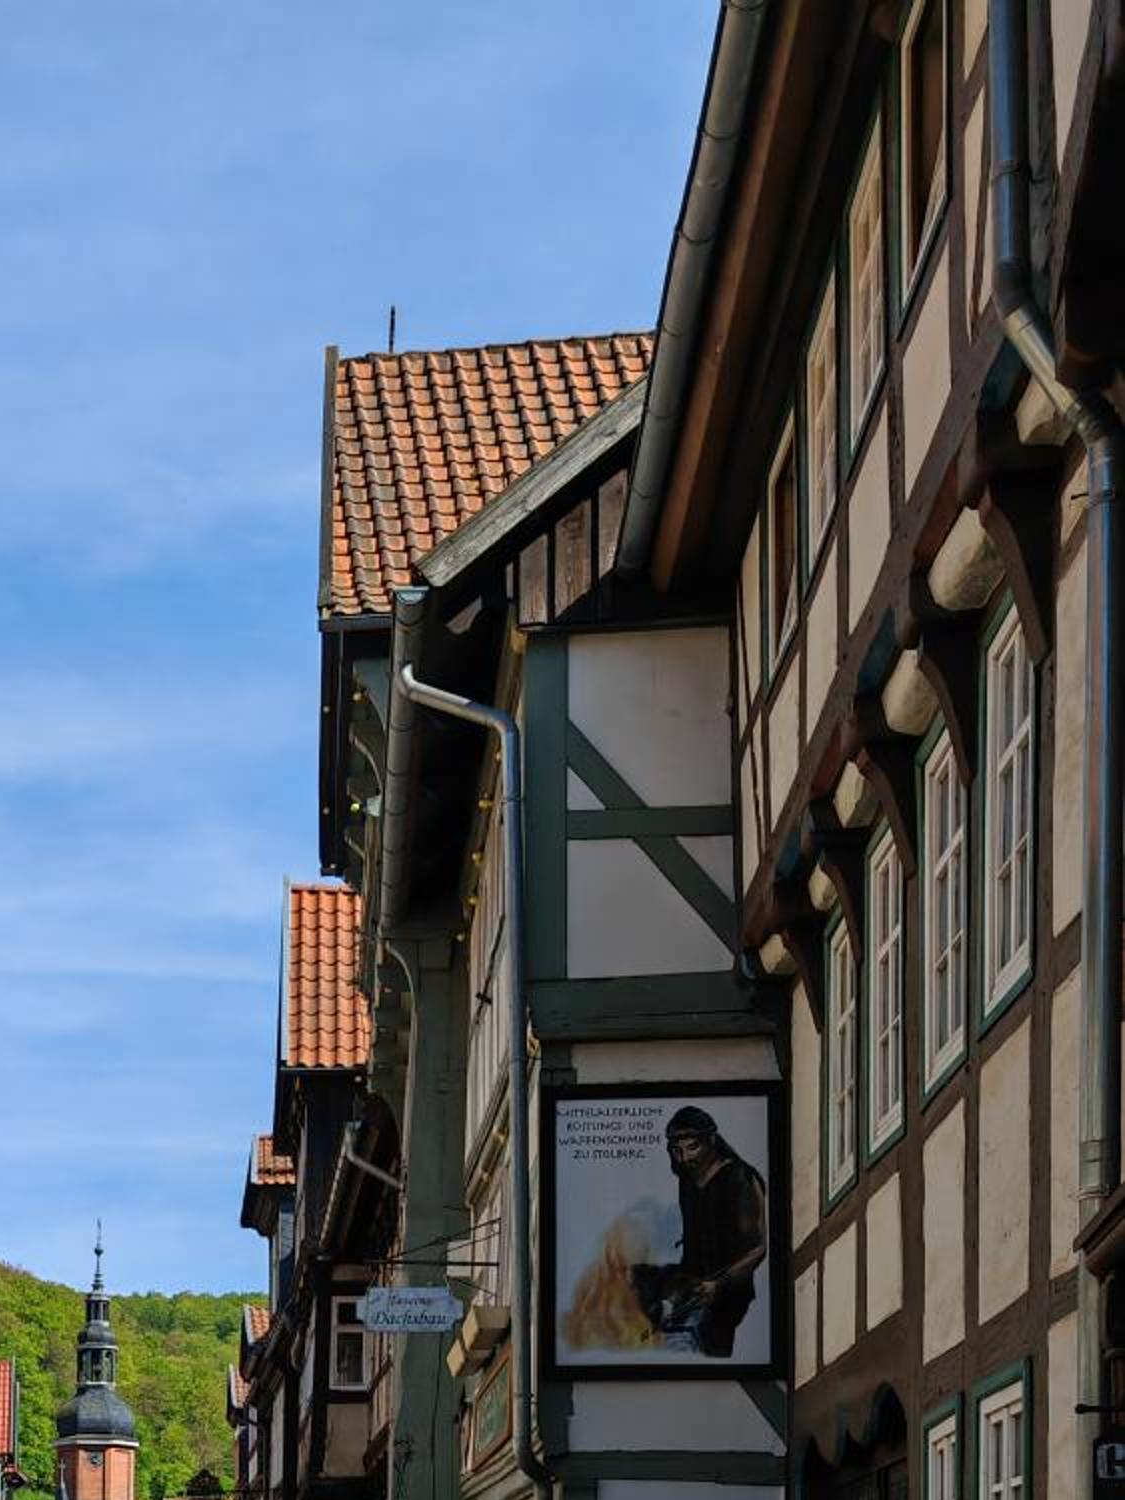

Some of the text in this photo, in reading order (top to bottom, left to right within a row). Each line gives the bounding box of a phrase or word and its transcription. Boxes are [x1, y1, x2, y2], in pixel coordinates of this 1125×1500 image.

[628, 1120, 654, 1131] UND
[558, 1134, 661, 1145] WAFFENSCHMIEDE
[573, 1148, 589, 1159] ZU
